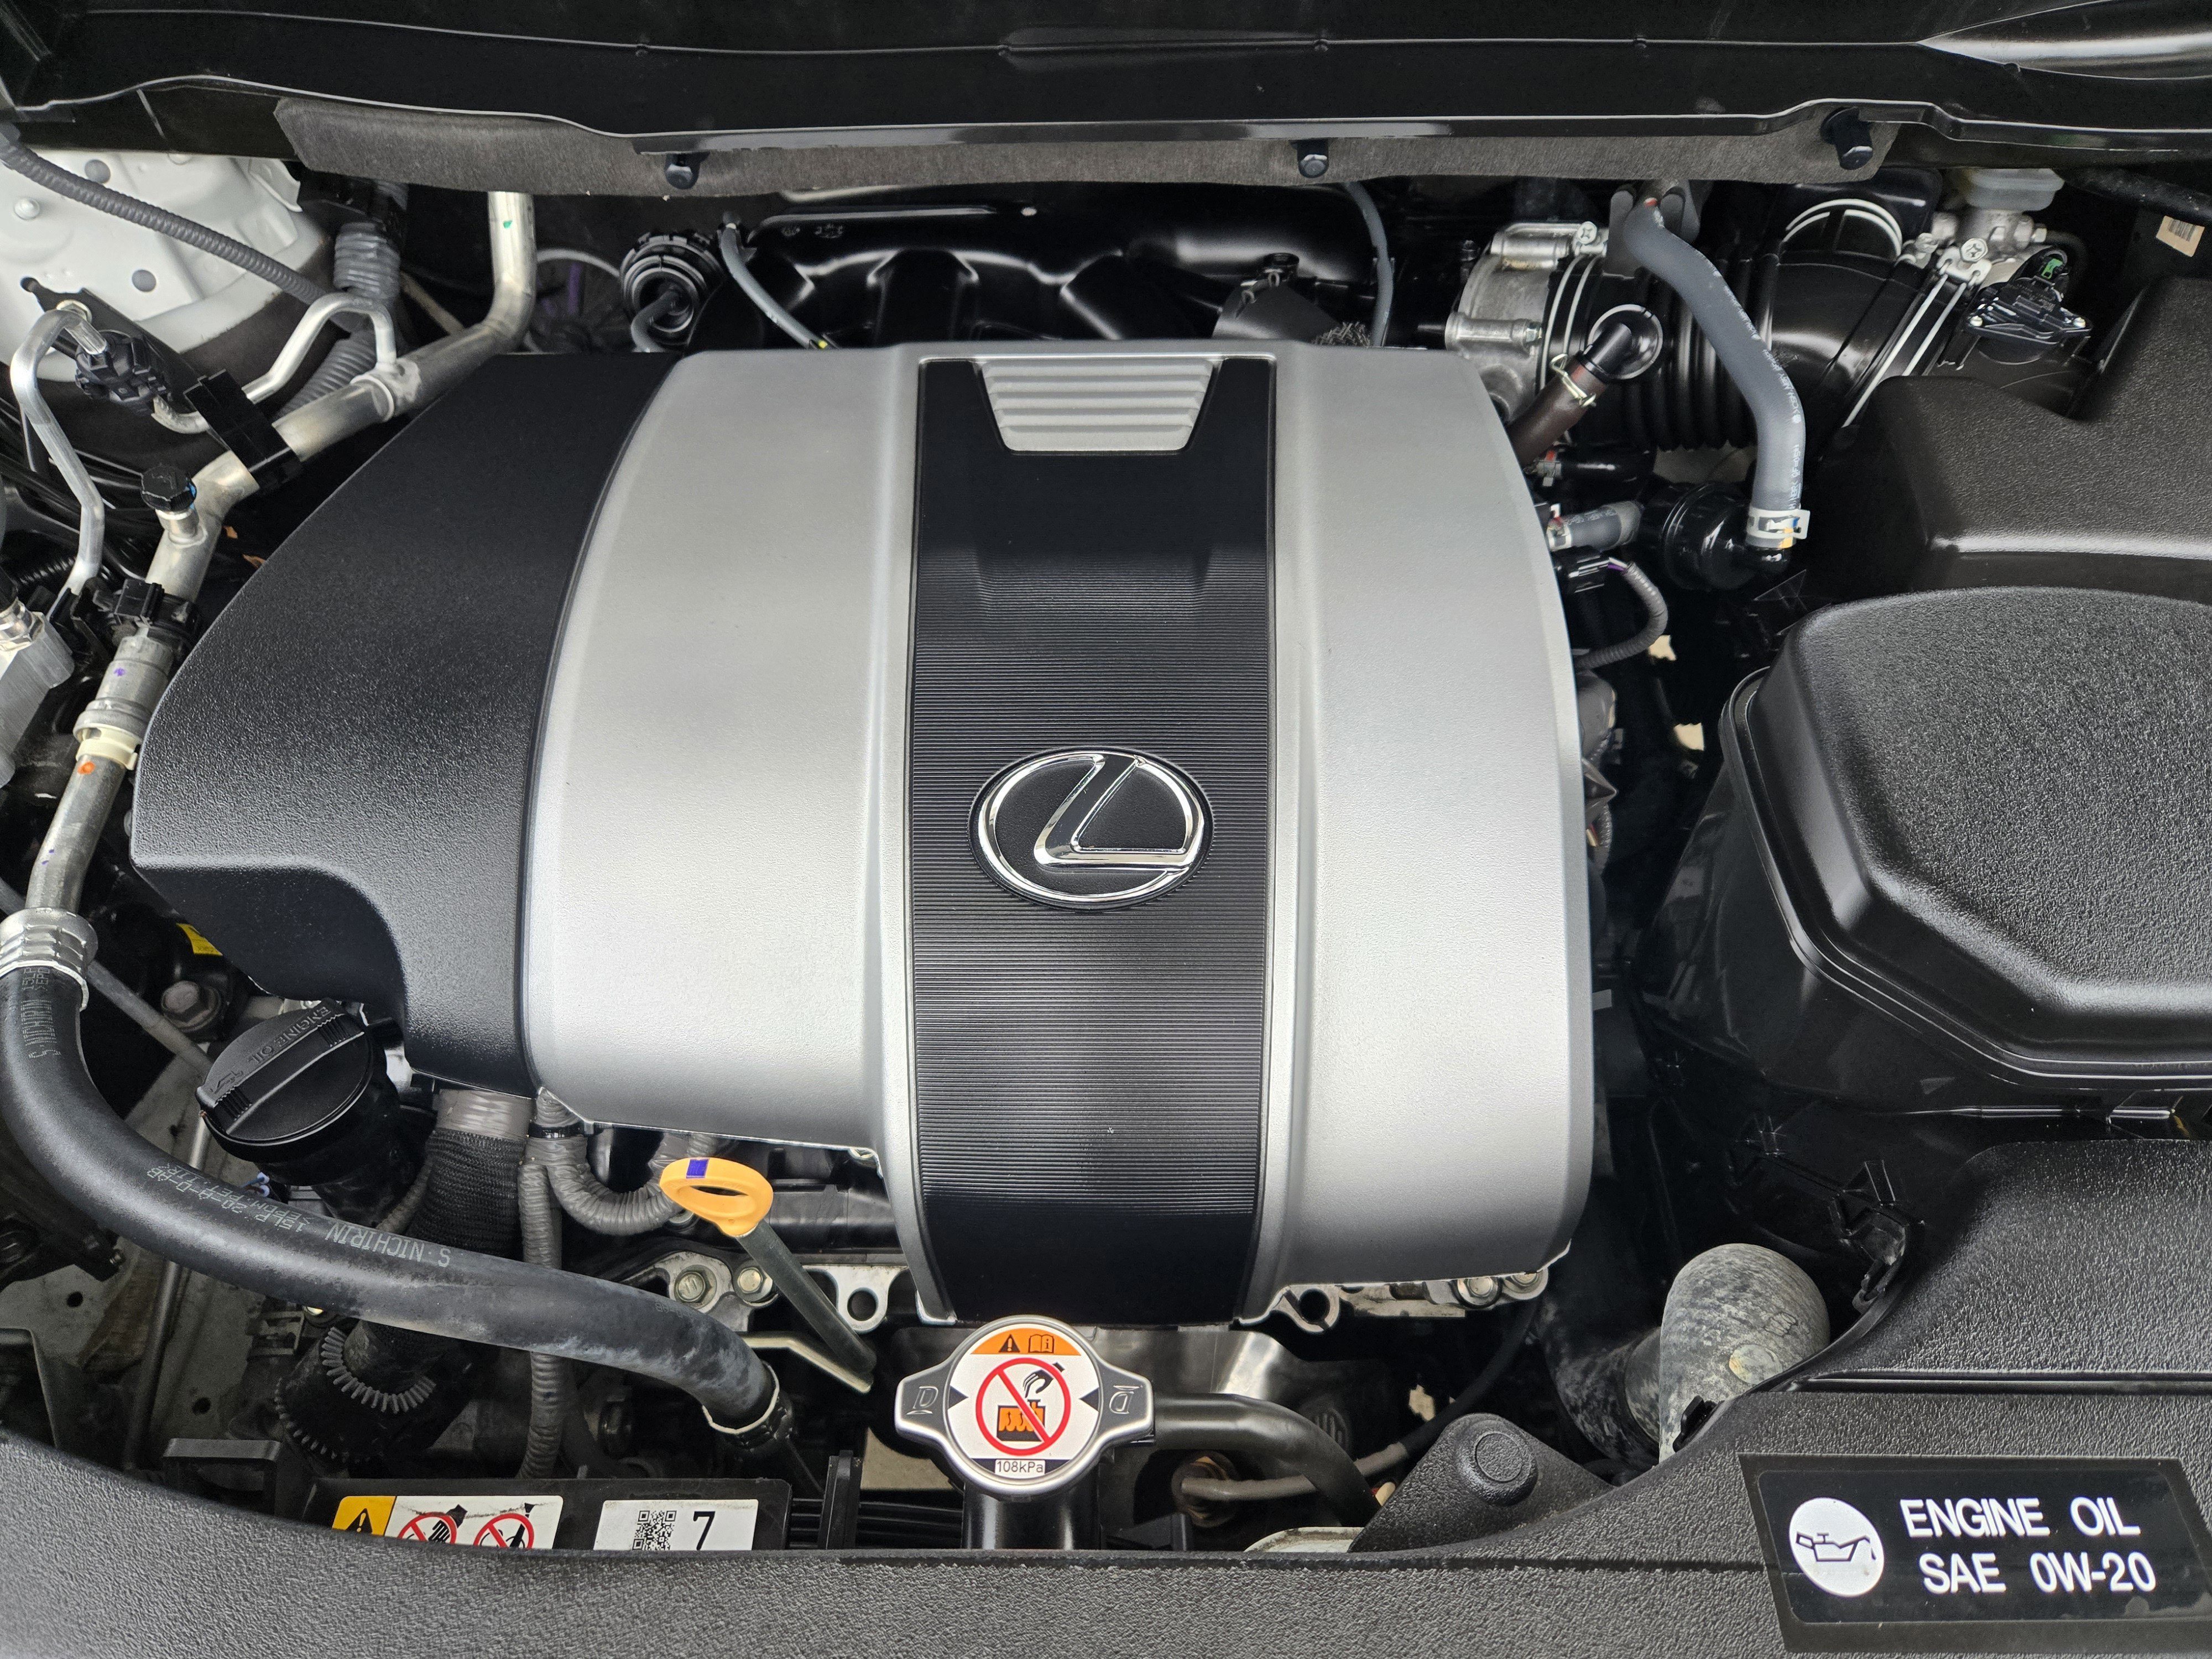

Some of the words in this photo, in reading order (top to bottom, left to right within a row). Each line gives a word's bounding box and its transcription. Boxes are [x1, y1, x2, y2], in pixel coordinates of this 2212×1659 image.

[274, 1006, 331, 1047] ENGINE
[248, 1045, 273, 1063] OIL
[997, 1460, 1044, 1473] 108kPa
[693, 1511, 716, 1551] 7
[1900, 1498, 2051, 1537] ENGINE
[2070, 1496, 2141, 1536] OIL
[1918, 1552, 2007, 1594] SAE
[2030, 1551, 2156, 1592] 0W-20
